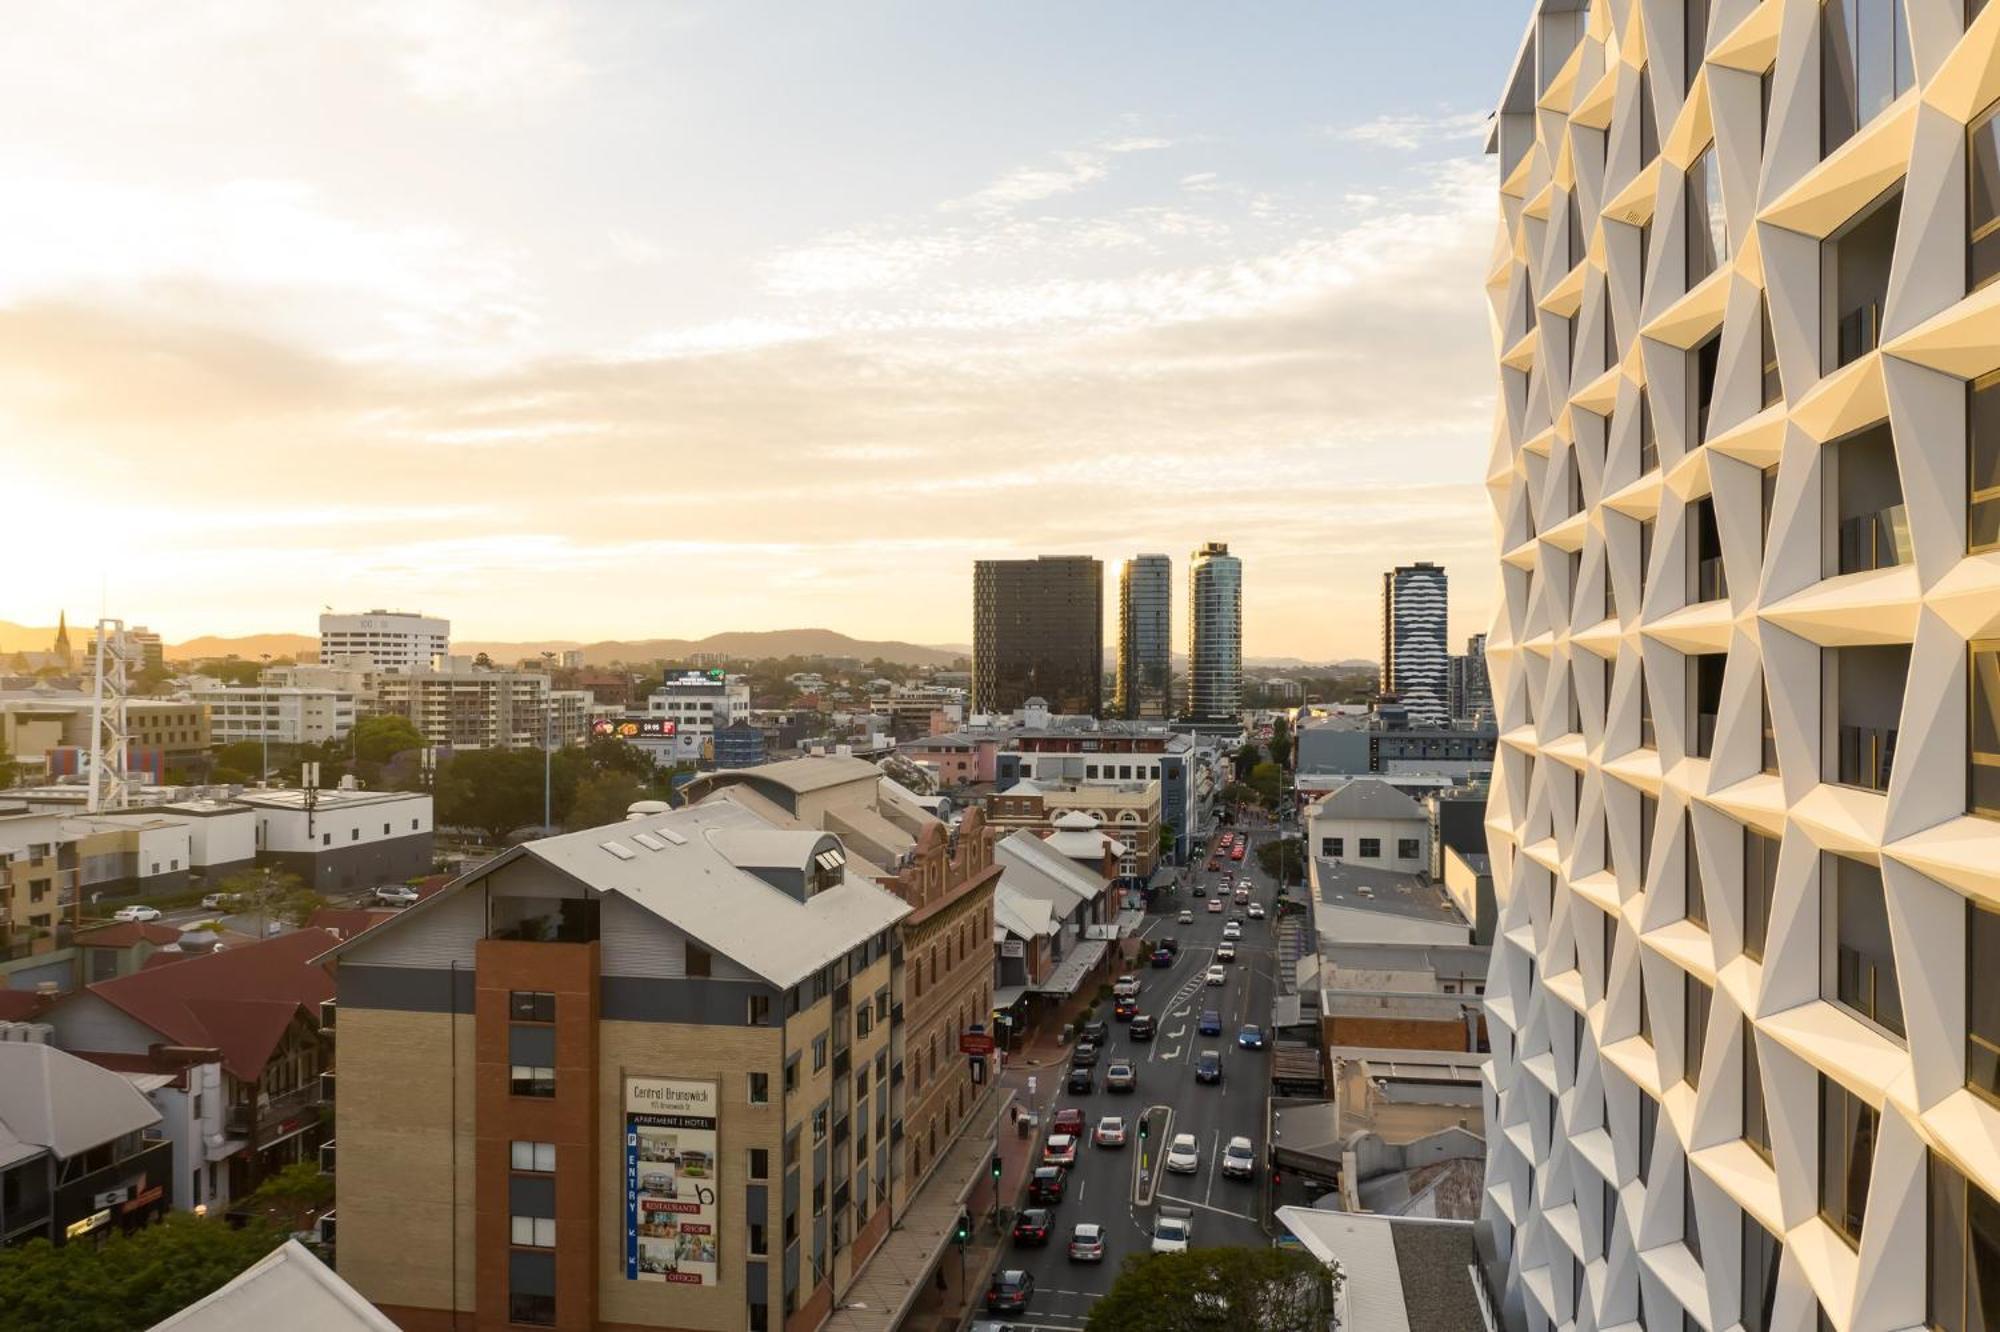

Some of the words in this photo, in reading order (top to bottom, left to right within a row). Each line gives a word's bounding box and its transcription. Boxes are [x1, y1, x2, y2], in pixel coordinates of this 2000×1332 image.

[634, 1086, 664, 1100] Central
[666, 1087, 708, 1102] Brunswick
[634, 1115, 677, 1125] APARTMENT
[685, 1119, 708, 1127] HOTEL
[645, 1202, 698, 1213] RESTAURANTS
